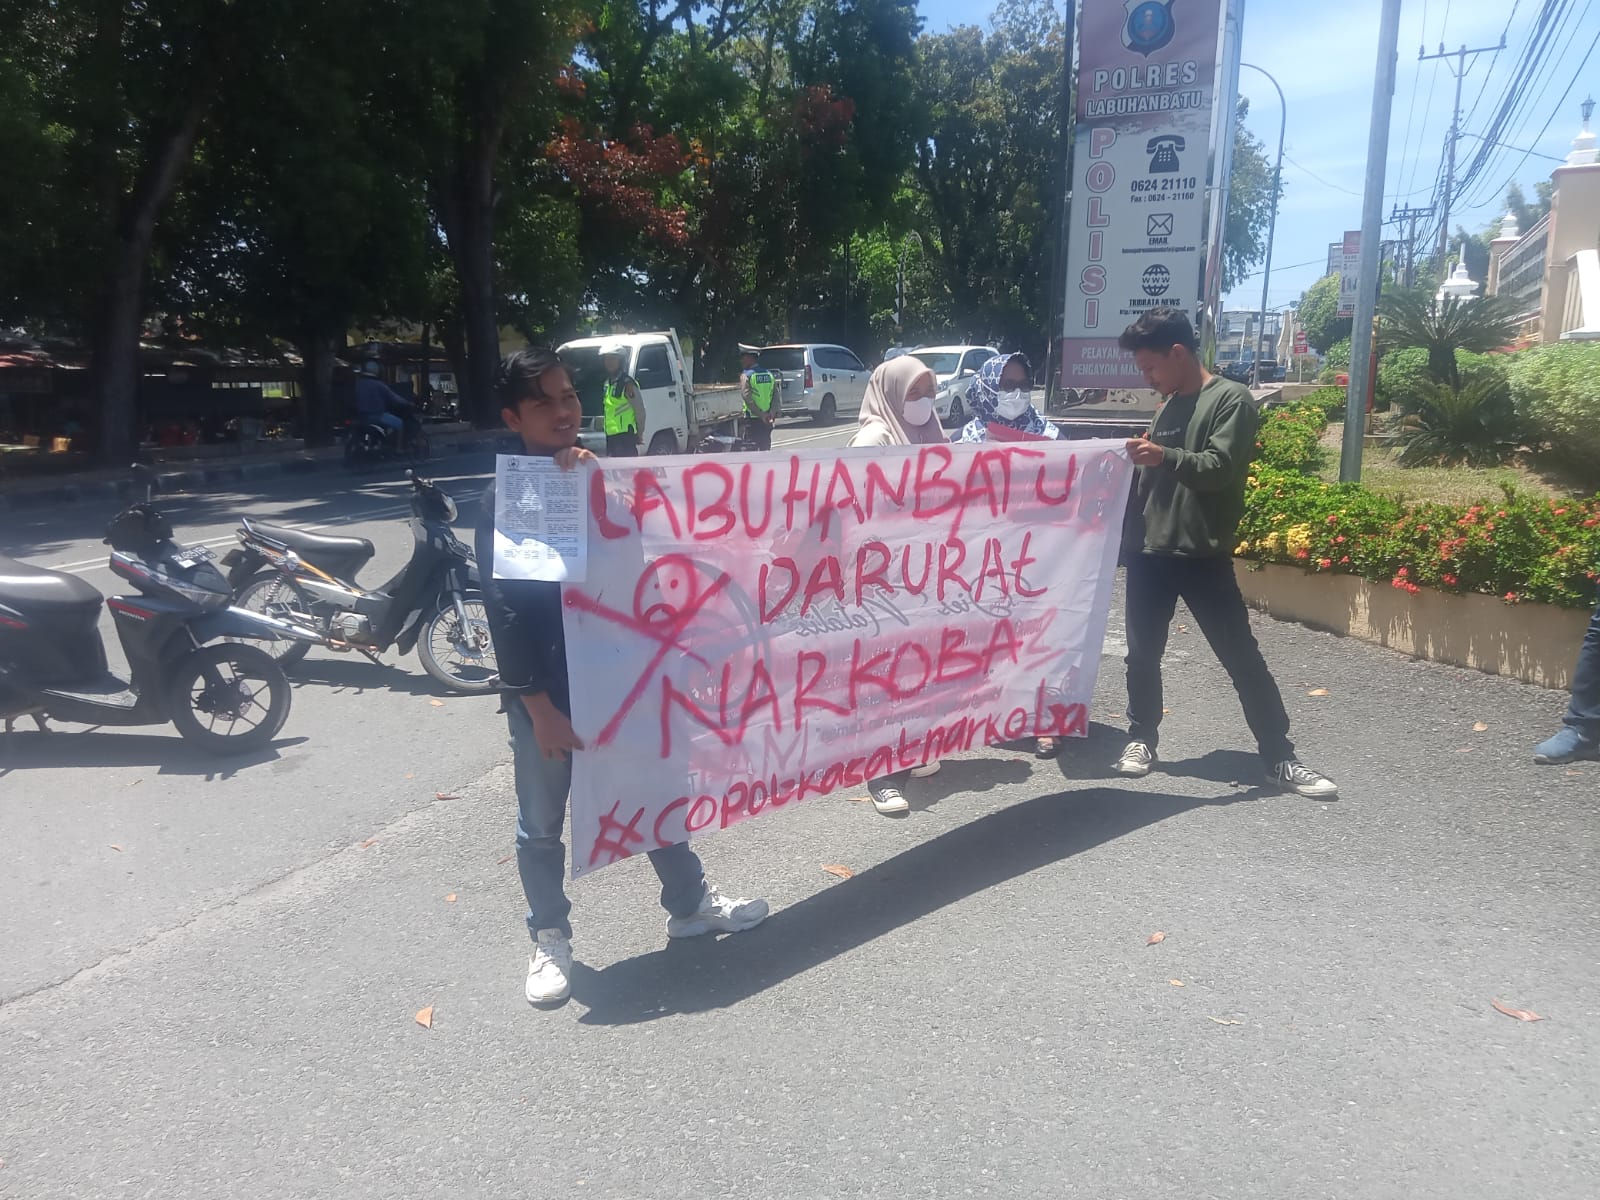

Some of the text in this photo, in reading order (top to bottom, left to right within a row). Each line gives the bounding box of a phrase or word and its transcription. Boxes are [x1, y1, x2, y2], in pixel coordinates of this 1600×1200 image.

[1093, 60, 1198, 94] POLRES
[1085, 90, 1203, 118] LABUHANBATU
[1130, 176, 1197, 192] 0624 21110
[1079, 127, 1117, 329] POLISI
[1161, 298, 1181, 307] NEWS
[1072, 362, 1118, 376] PENGAYOM
[590, 445, 1076, 540] LABUHANBATU
[118, 609, 145, 621] HONDA
[661, 617, 1023, 759] NARKOBA
